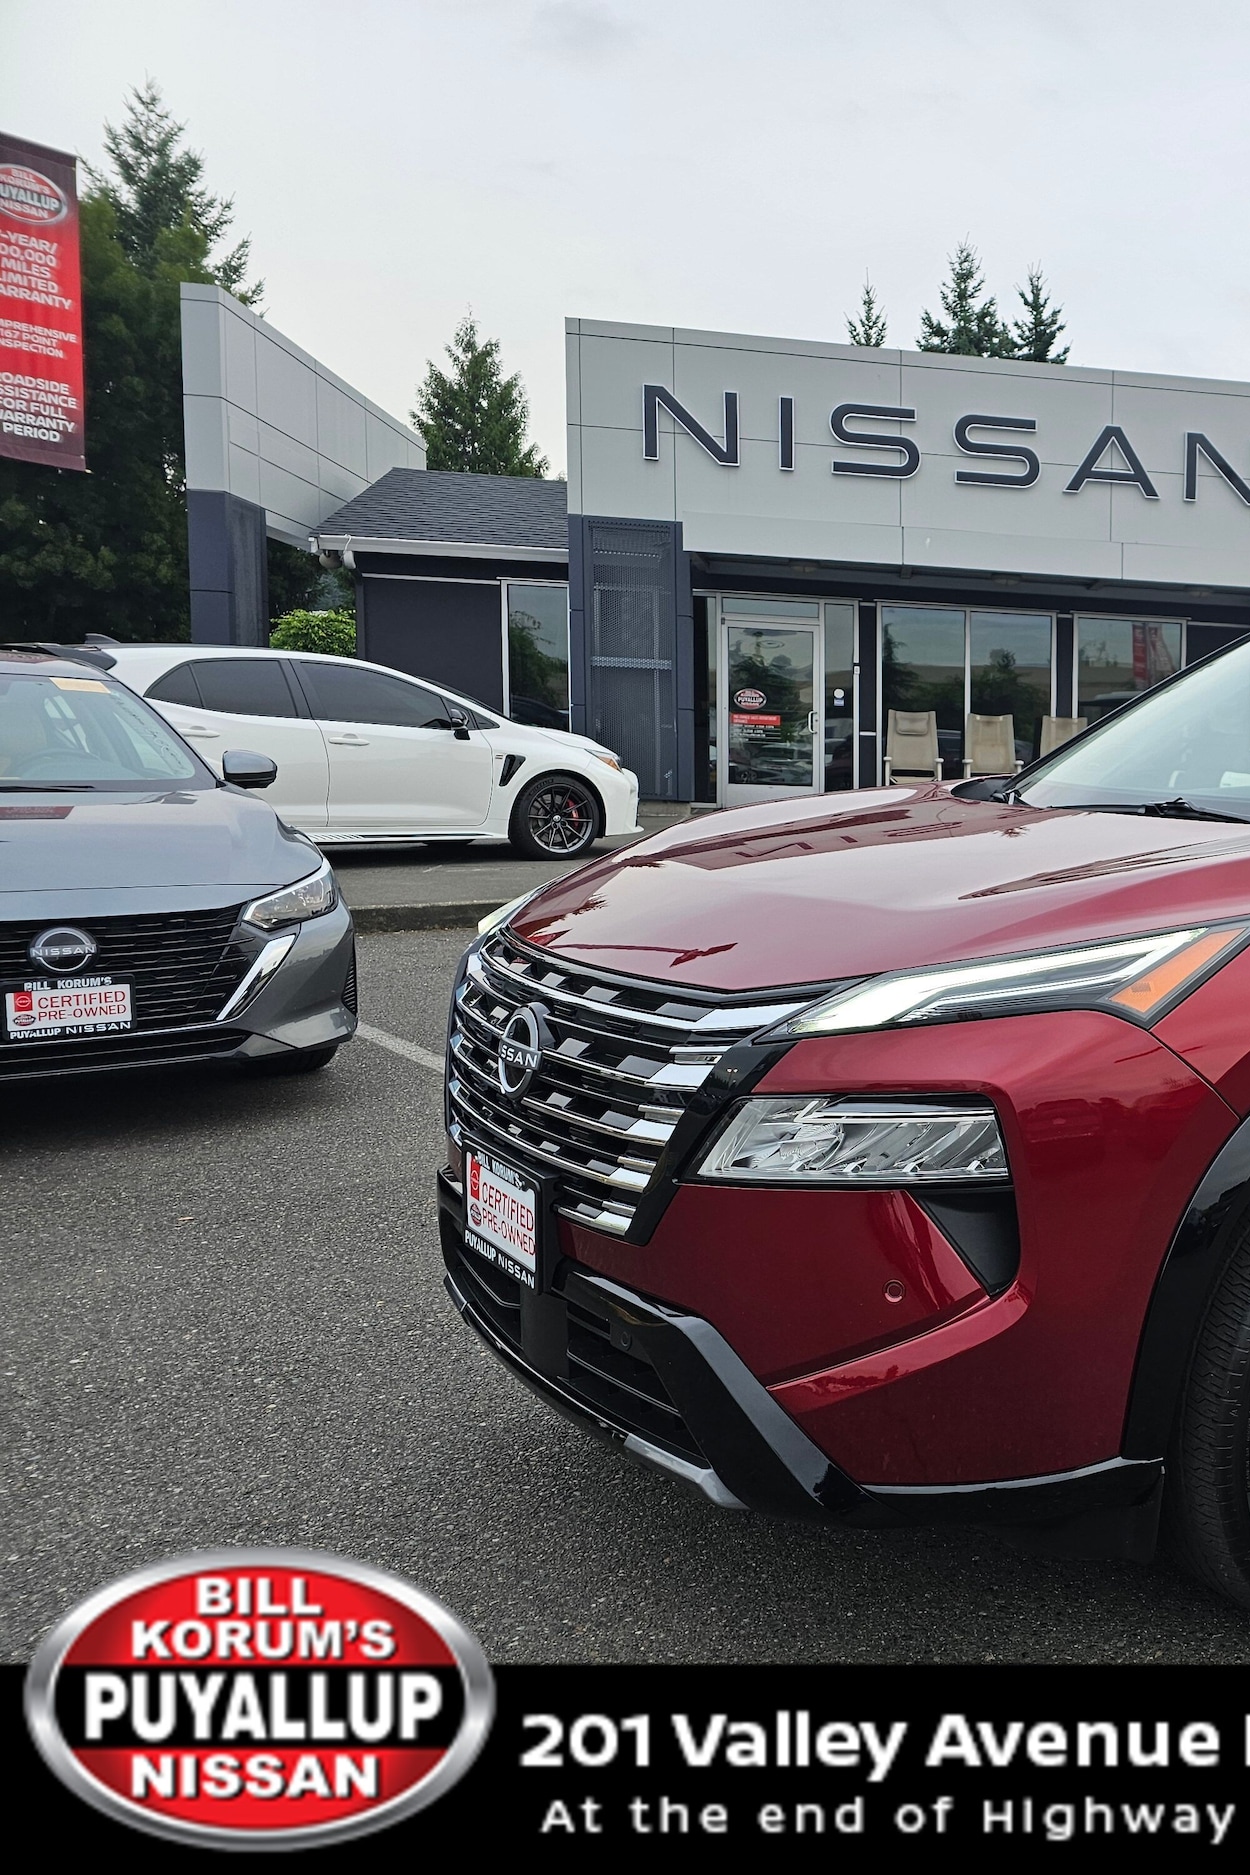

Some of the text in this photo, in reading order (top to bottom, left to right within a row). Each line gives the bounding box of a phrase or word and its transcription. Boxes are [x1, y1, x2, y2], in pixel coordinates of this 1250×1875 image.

[11, 167, 36, 183] BILL
[0, 182, 60, 211] UYALLUP
[0, 229, 58, 255] -YEAR/
[0, 242, 57, 267] 00,000
[1, 256, 52, 279] MILES
[0, 270, 59, 294] IMITED
[0, 283, 72, 310] ARRANTY
[0, 337, 65, 359] NSPECTION
[22, 332, 58, 348] POINT
[0, 371, 70, 395] OADSIDE
[30, 401, 67, 420] FULL
[3, 421, 62, 442] PERIOD
[32, 946, 96, 957] NISSAN
[24, 976, 112, 992] BILL KORUM'S
[37, 990, 126, 1009] CERTIFIED
[38, 1004, 127, 1021] PRE-OWNED
[10, 1021, 131, 1040] PUYALLUP NISSAN
[501, 1044, 538, 1068] SSAN
[482, 1182, 534, 1232] CERTIFIED
[482, 1207, 537, 1256] PRE-OWNED
[465, 1230, 535, 1289] PUYALLUP NISSAN
